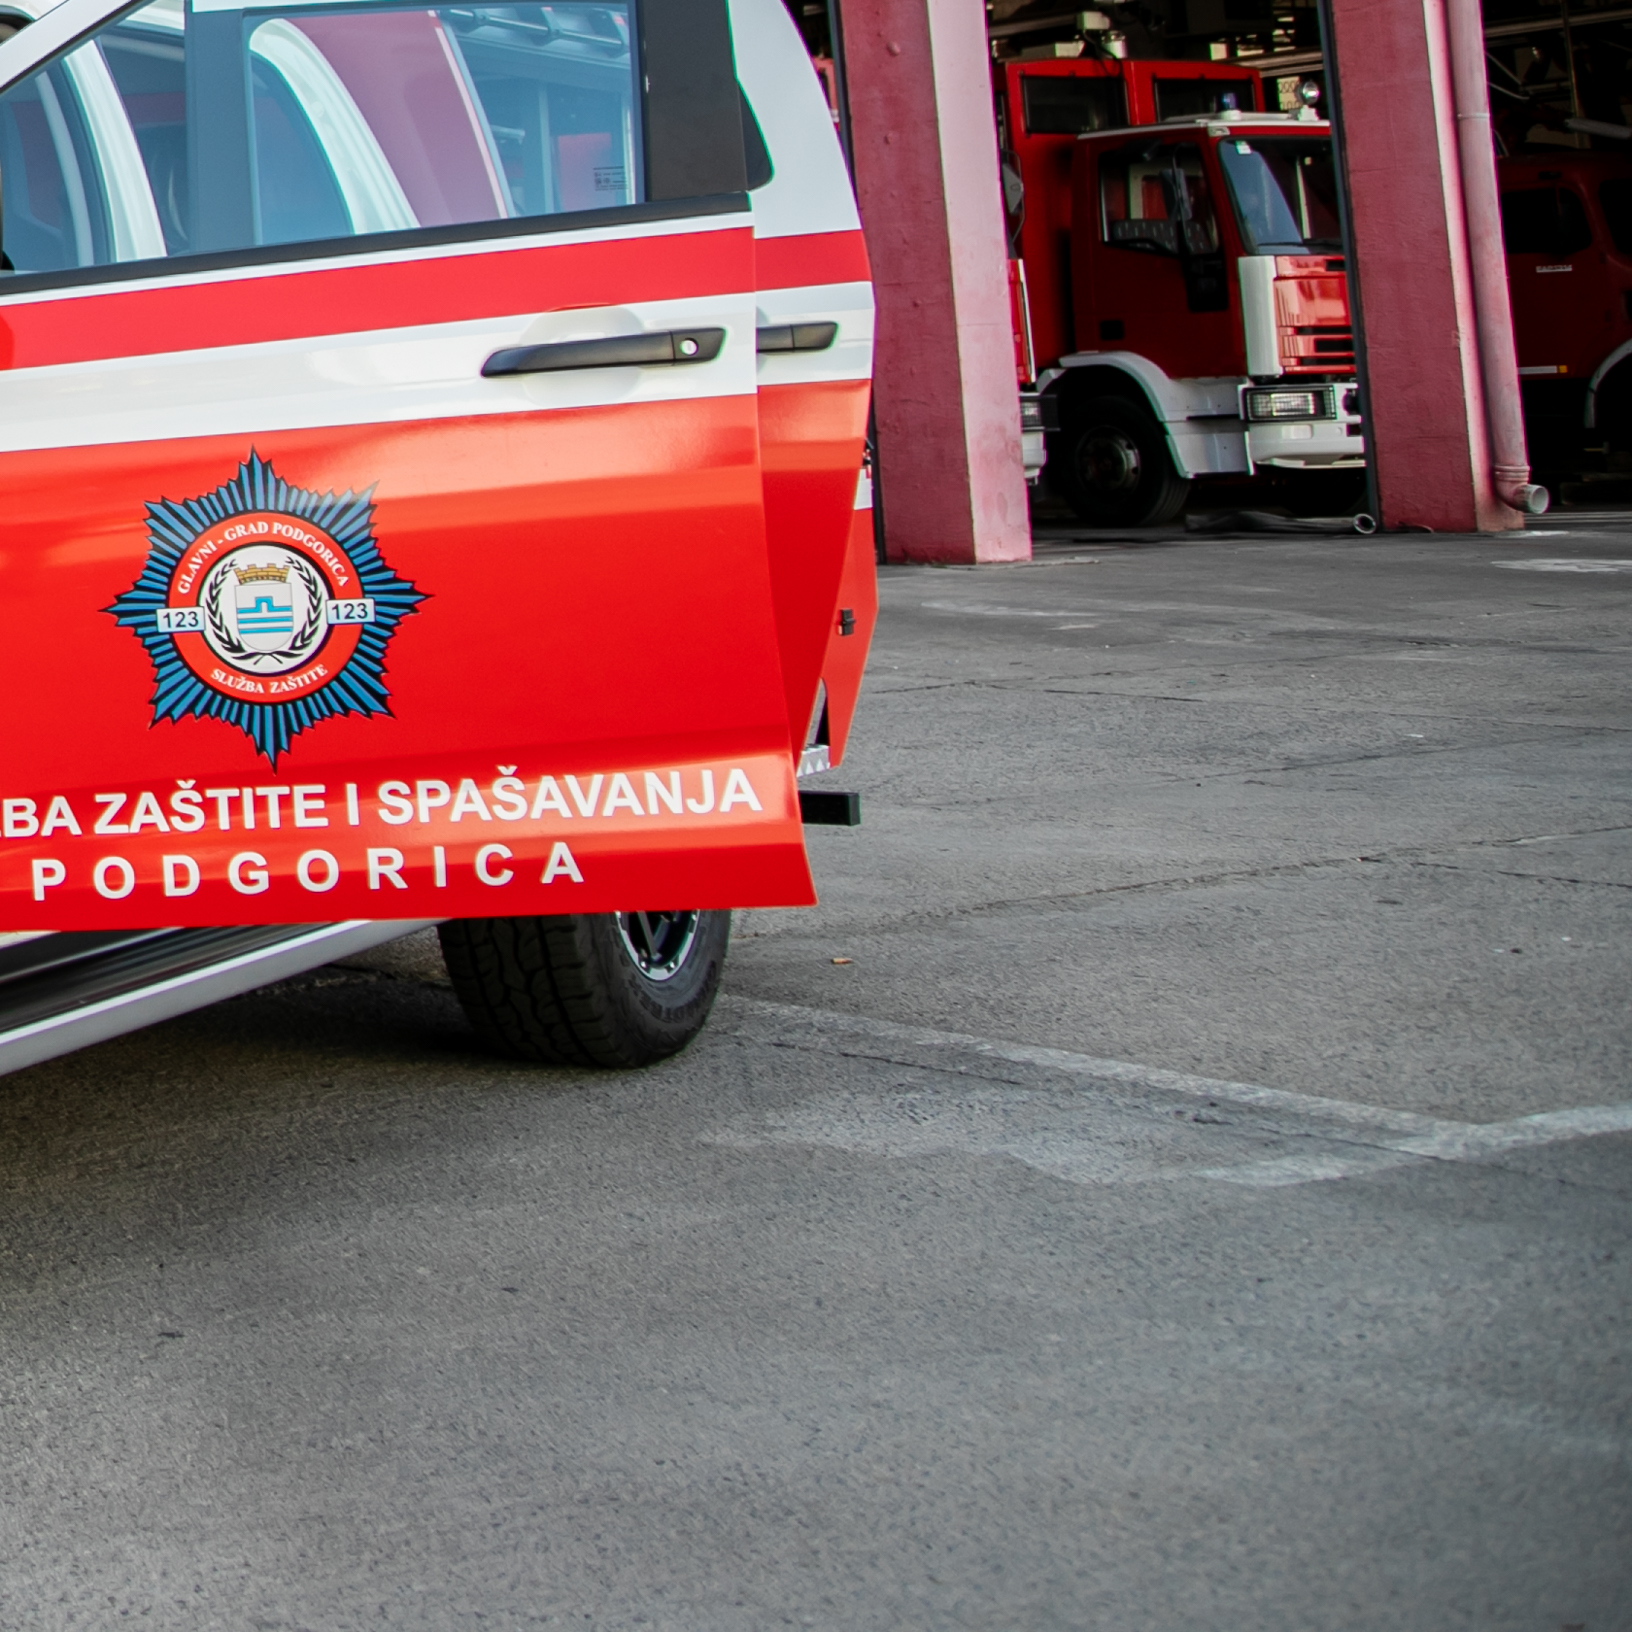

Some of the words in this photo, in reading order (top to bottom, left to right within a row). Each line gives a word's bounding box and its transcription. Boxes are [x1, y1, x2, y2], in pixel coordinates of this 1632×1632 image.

[177, 540, 218, 595] GLAVNI
[223, 521, 269, 542] GRAD
[272, 521, 350, 588] PODGORICA
[162, 611, 200, 629] 123
[330, 602, 369, 621] 123
[211, 668, 266, 695] SLUŽBA
[269, 663, 329, 695] ZAŠTITE
[93, 779, 329, 835] ZAŠTITE
[346, 783, 360, 826] I
[378, 767, 766, 826] SPAŠAVANJA
[32, 841, 584, 901] PODGORICA
